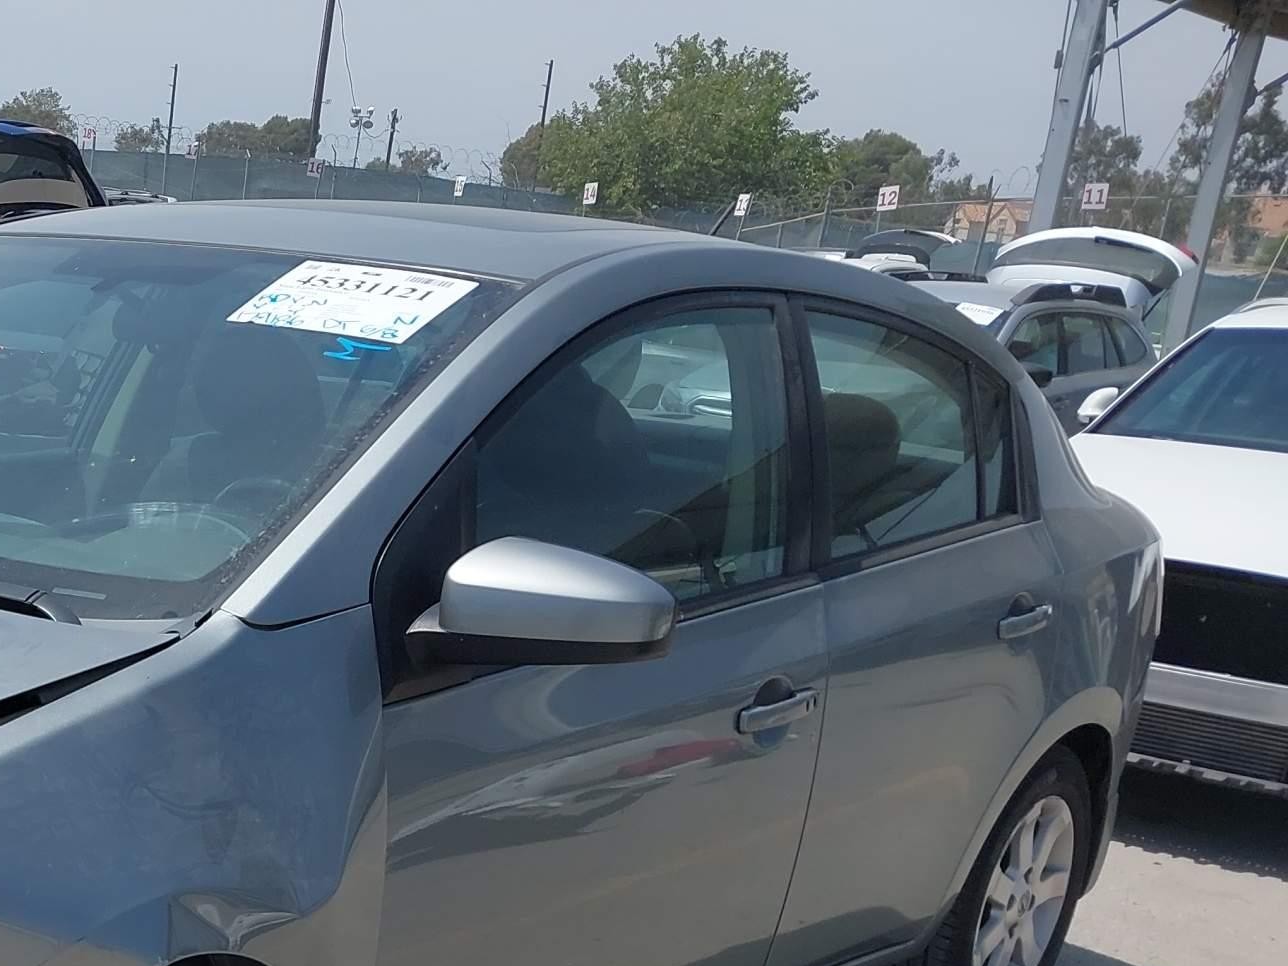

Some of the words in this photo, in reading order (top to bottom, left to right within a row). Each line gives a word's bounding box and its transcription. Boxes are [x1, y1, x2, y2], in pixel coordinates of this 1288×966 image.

[83, 128, 92, 139] 18
[308, 161, 322, 174] 16
[584, 188, 596, 201] 14
[879, 191, 897, 207] 12
[1084, 188, 1105, 205] 11
[296, 275, 434, 302] 45331121
